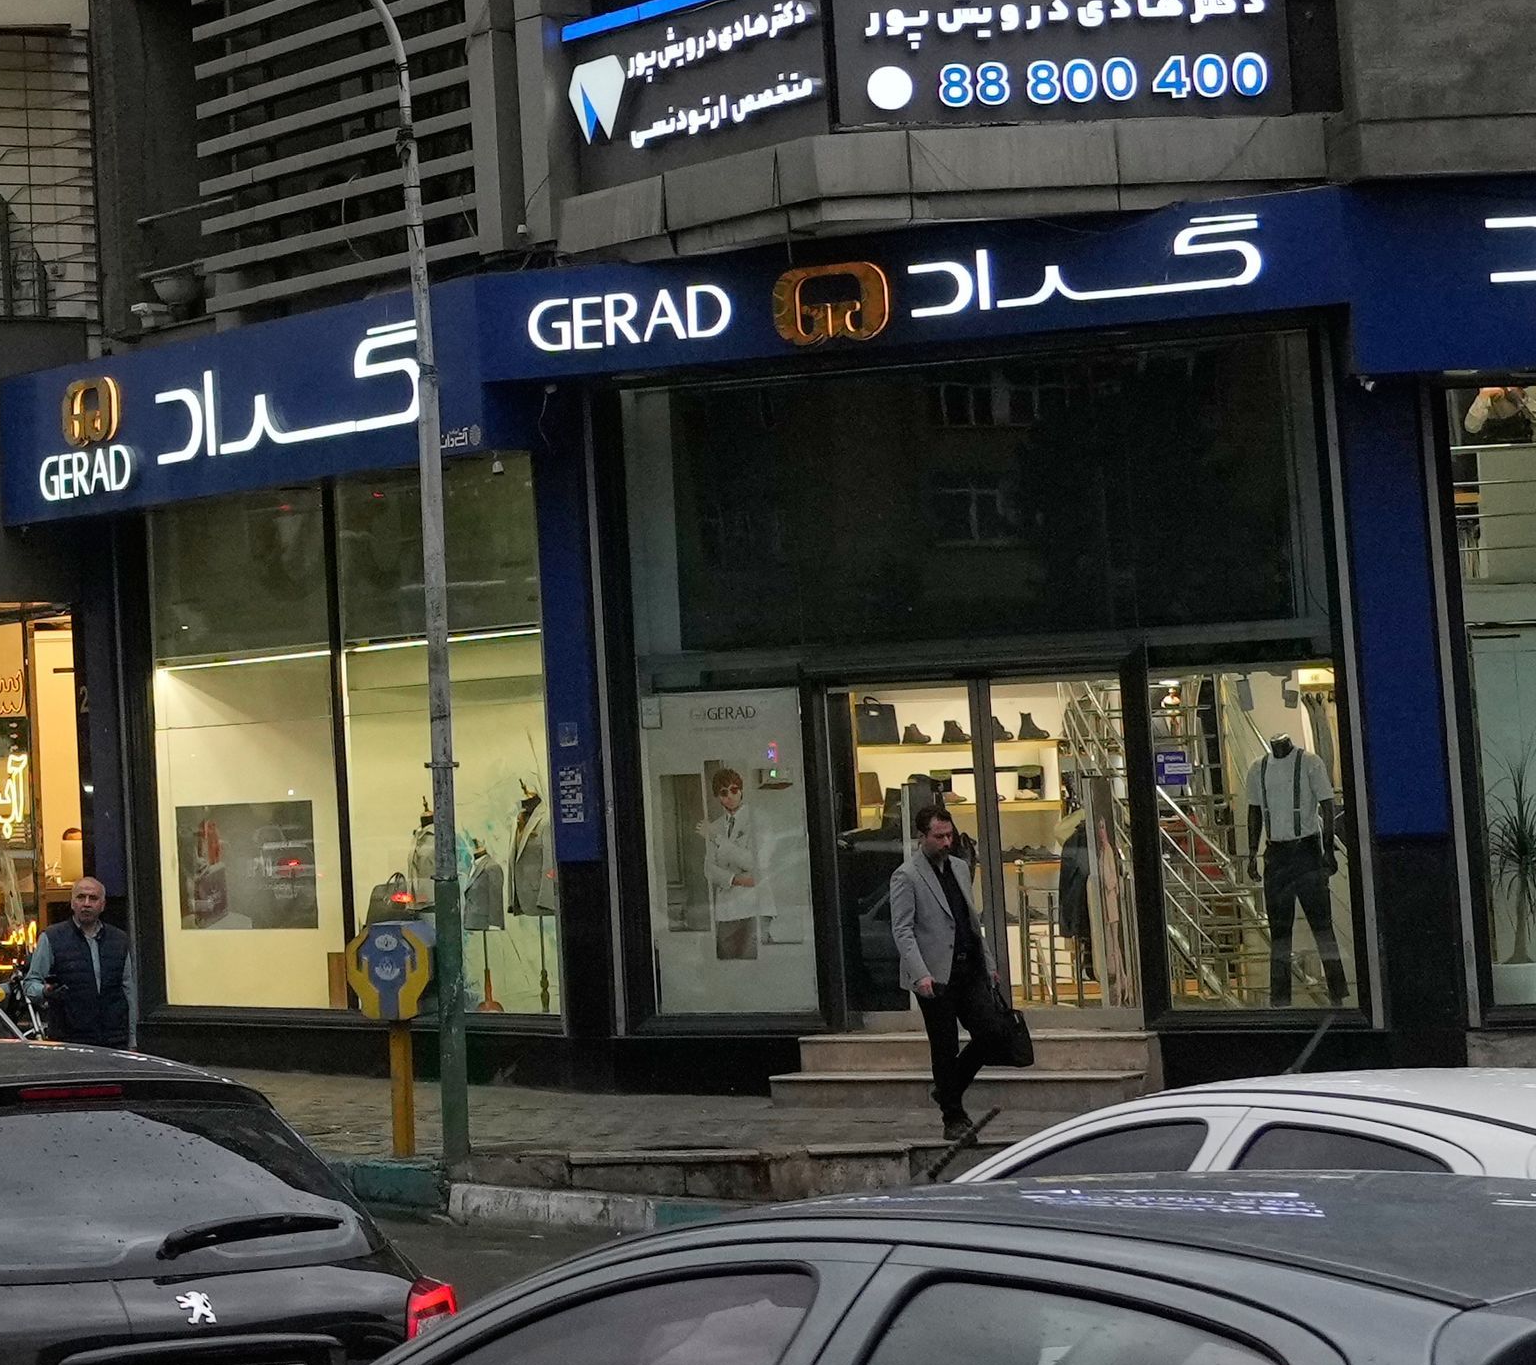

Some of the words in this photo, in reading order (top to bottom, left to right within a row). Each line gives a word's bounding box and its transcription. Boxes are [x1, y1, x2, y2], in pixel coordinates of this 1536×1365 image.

[718, 13, 768, 51] هادی
[769, 0, 806, 39] دکتر
[731, 72, 814, 122] متخصص
[938, 63, 1010, 108] 88
[1026, 56, 1139, 104] 800
[1151, 51, 1269, 100] 400
[630, 94, 727, 149] ارتودنسی
[907, 212, 1263, 317] گراد
[527, 283, 732, 352] GERAD
[155, 319, 420, 466] گراد
[39, 442, 132, 502] GERAD
[706, 705, 756, 721] GERAD
